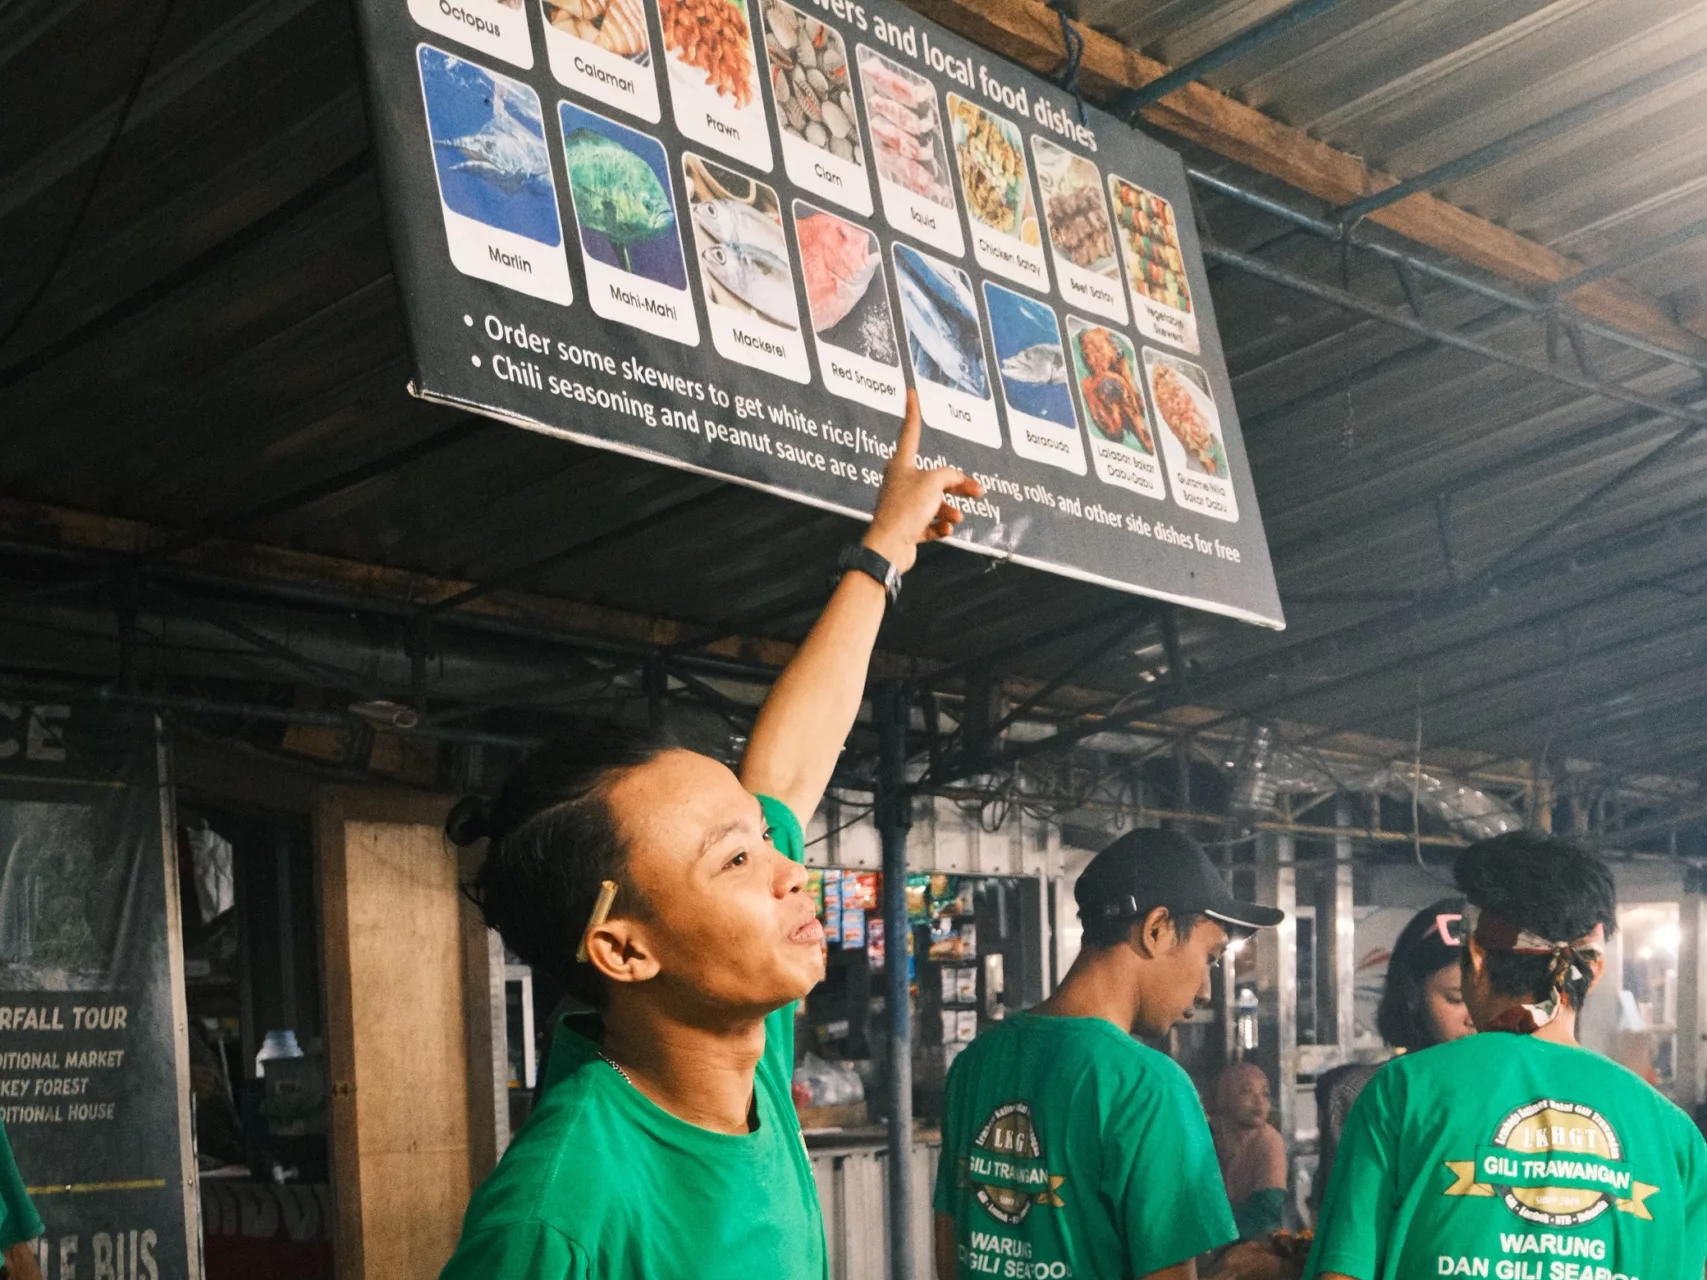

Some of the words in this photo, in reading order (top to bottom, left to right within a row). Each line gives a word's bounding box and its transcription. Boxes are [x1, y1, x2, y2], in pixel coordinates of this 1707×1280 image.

[439, 0, 501, 37] Octopus
[574, 56, 635, 94] Calamari
[872, 15, 918, 59] and
[922, 32, 975, 90] local
[979, 65, 1030, 118] food
[1033, 97, 1097, 152] dishes
[706, 113, 740, 142] Prawn
[814, 163, 842, 187] Clam
[910, 206, 937, 230] Squid
[488, 244, 533, 275] Marlin
[979, 238, 1015, 264] Chicken
[610, 283, 678, 321] Mahi-Mahi
[733, 328, 787, 359] Mackerel
[831, 362, 852, 382] Red
[855, 370, 896, 396] Snapper
[948, 403, 971, 422] Tuna
[484, 314, 550, 356] Order
[557, 342, 617, 376] some
[621, 356, 705, 402] skewers
[708, 383, 730, 408] to
[734, 395, 764, 420] get
[768, 405, 818, 437] white
[972, 470, 1023, 502] spring
[1024, 483, 1057, 508] rolls
[1057, 494, 1082, 517] and
[1084, 504, 1123, 528] other
[1126, 513, 1152, 537] side
[1154, 521, 1194, 550] dishes
[1194, 533, 1213, 556] for
[1215, 538, 1241, 563] free
[492, 354, 543, 390] Chili
[549, 375, 657, 427] seasoning
[660, 407, 700, 434] and
[704, 419, 773, 456] peanut
[776, 439, 826, 471] sauce
[830, 457, 858, 481] are
[940, 492, 1000, 525] arately
[72, 1006, 128, 1031] TOUR
[65, 1049, 125, 1069] MARKET
[0, 1079, 31, 1098] KEY
[35, 1077, 89, 1097] FOREST
[68, 1102, 116, 1121] HOUSE
[1522, 1125, 1597, 1149] LKHGT
[1484, 1156, 1518, 1178] GILI
[1522, 1160, 1631, 1190] TRAWANGAN
[1500, 1232, 1606, 1260] WARUNG
[1438, 1256, 1489, 1278] DAN
[1495, 1260, 1542, 1280] GILI
